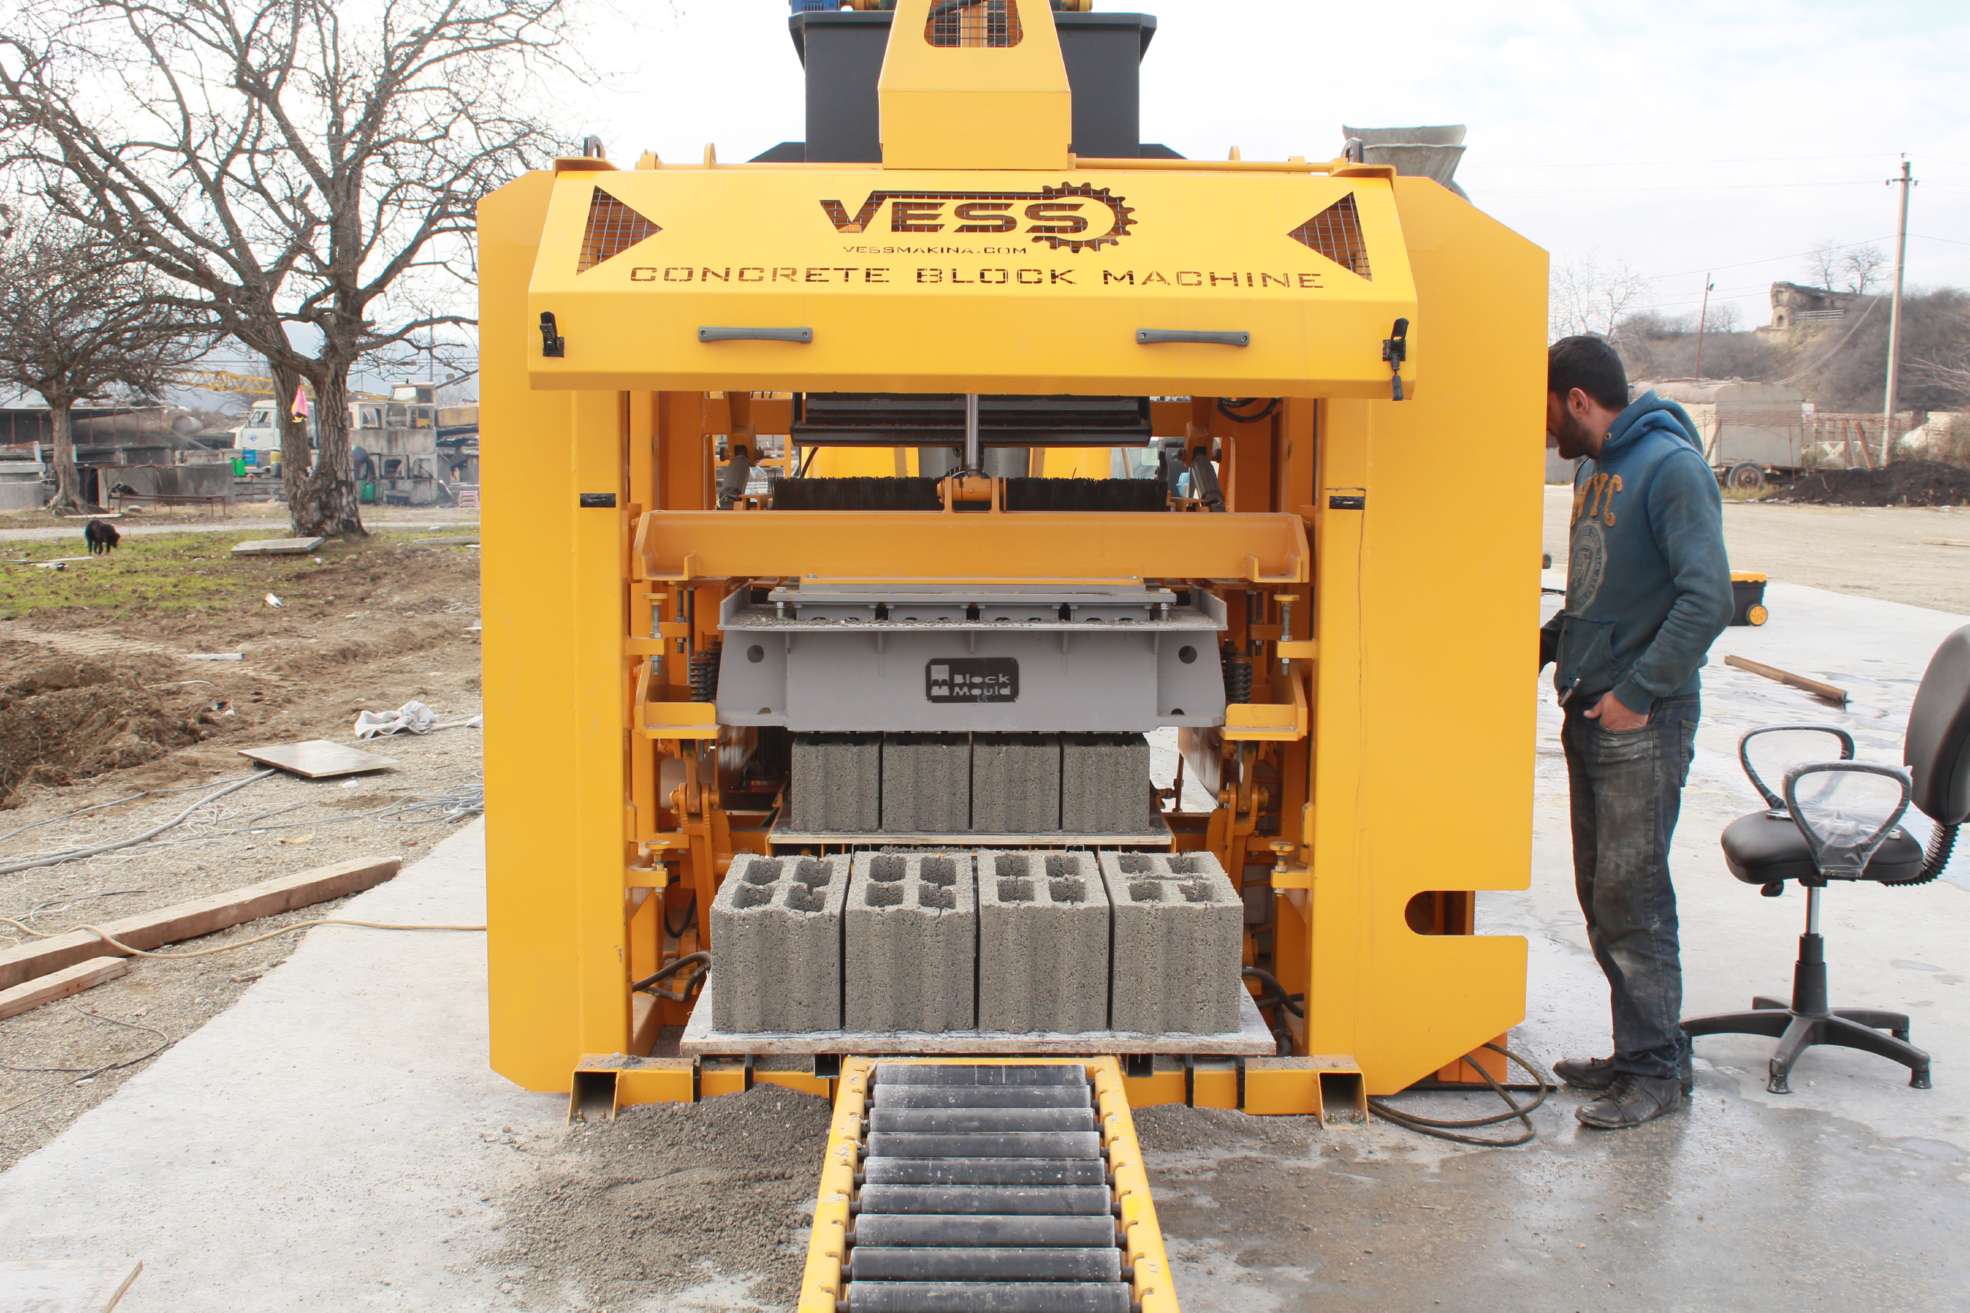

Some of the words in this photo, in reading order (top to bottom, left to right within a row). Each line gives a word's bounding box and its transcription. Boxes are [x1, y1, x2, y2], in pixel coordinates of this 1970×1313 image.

[819, 190, 1089, 234] VESS
[842, 245, 1028, 255] VESSMAKINA.COM
[630, 266, 891, 283] CONCRETE
[916, 267, 1078, 285] BLOCK
[1102, 269, 1325, 289] MACHINE
[953, 673, 1010, 684] Block
[952, 685, 1011, 696] Mould
